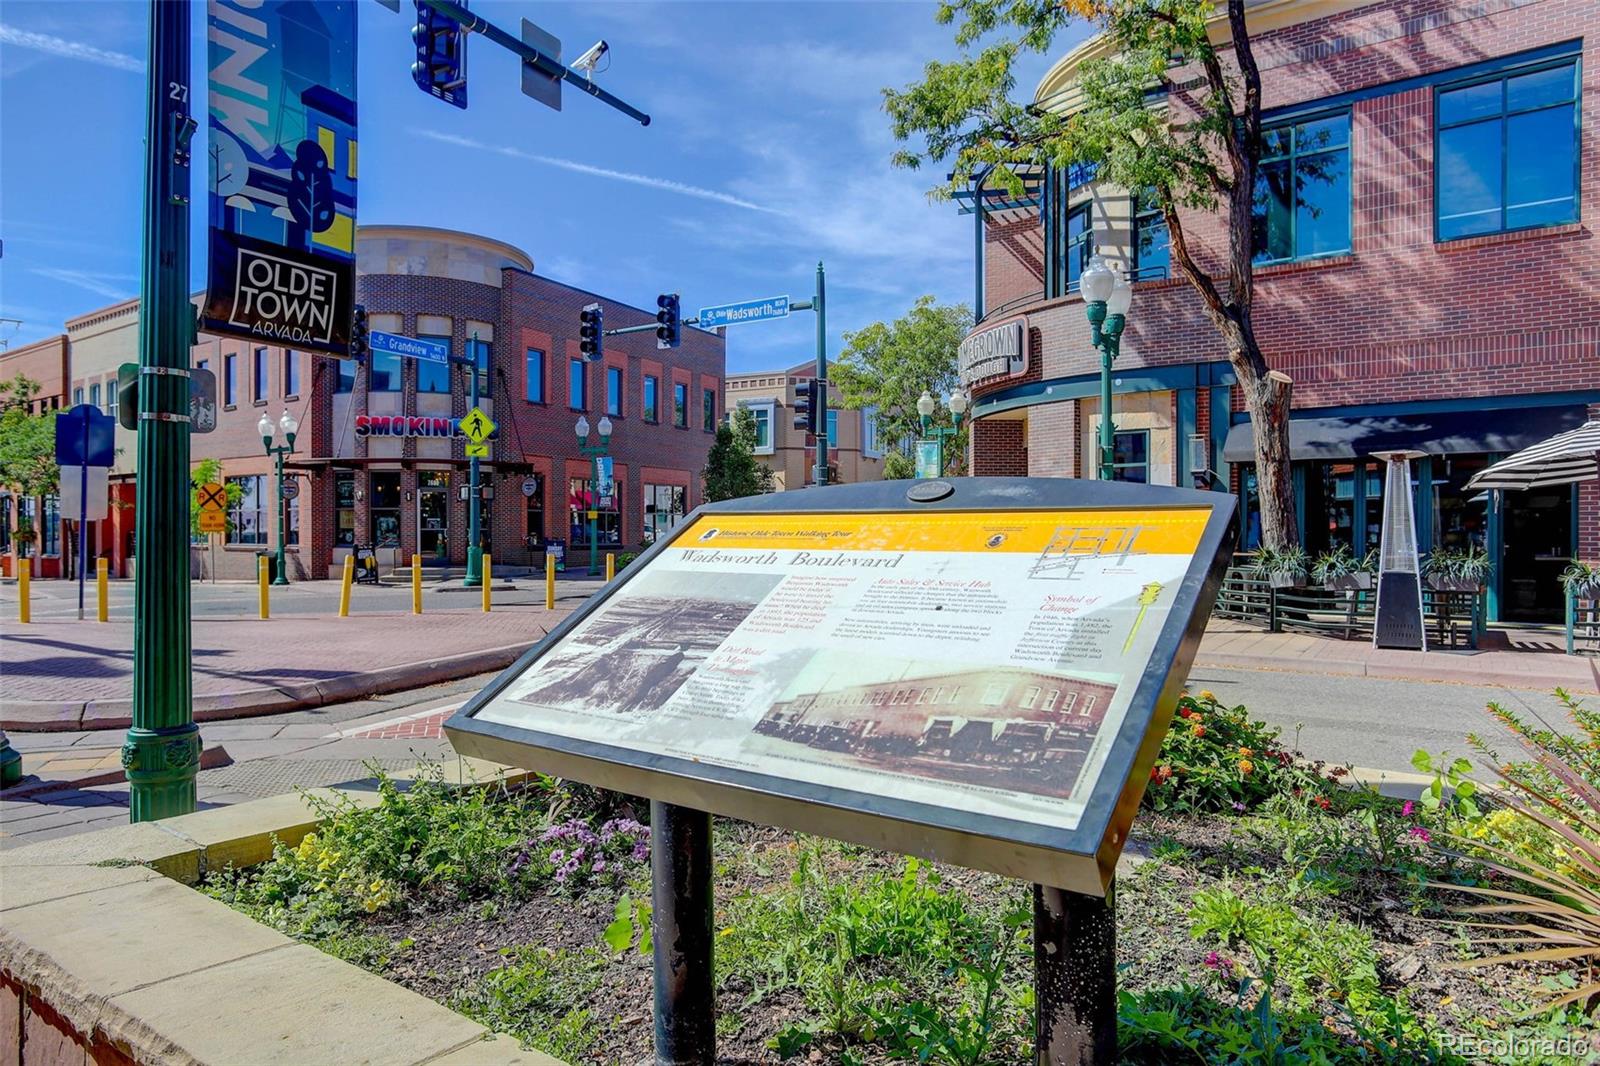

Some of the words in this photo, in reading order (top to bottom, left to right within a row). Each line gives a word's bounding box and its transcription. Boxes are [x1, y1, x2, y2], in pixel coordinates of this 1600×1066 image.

[208, 0, 269, 156] INK
[169, 81, 188, 103] 27
[247, 258, 326, 302] OLDE
[241, 286, 330, 327] TOWN
[726, 303, 773, 320] Wadsworth
[251, 321, 313, 345] ARVADA
[388, 337, 427, 355] Grandview
[356, 415, 449, 438] SMOKIN
[218, 494, 225, 502] R
[679, 549, 778, 566] Wadsworth
[788, 551, 905, 569] Boulevard
[1040, 602, 1079, 613] Change
[1044, 594, 1085, 605] Symbol
[1085, 596, 1102, 605] of
